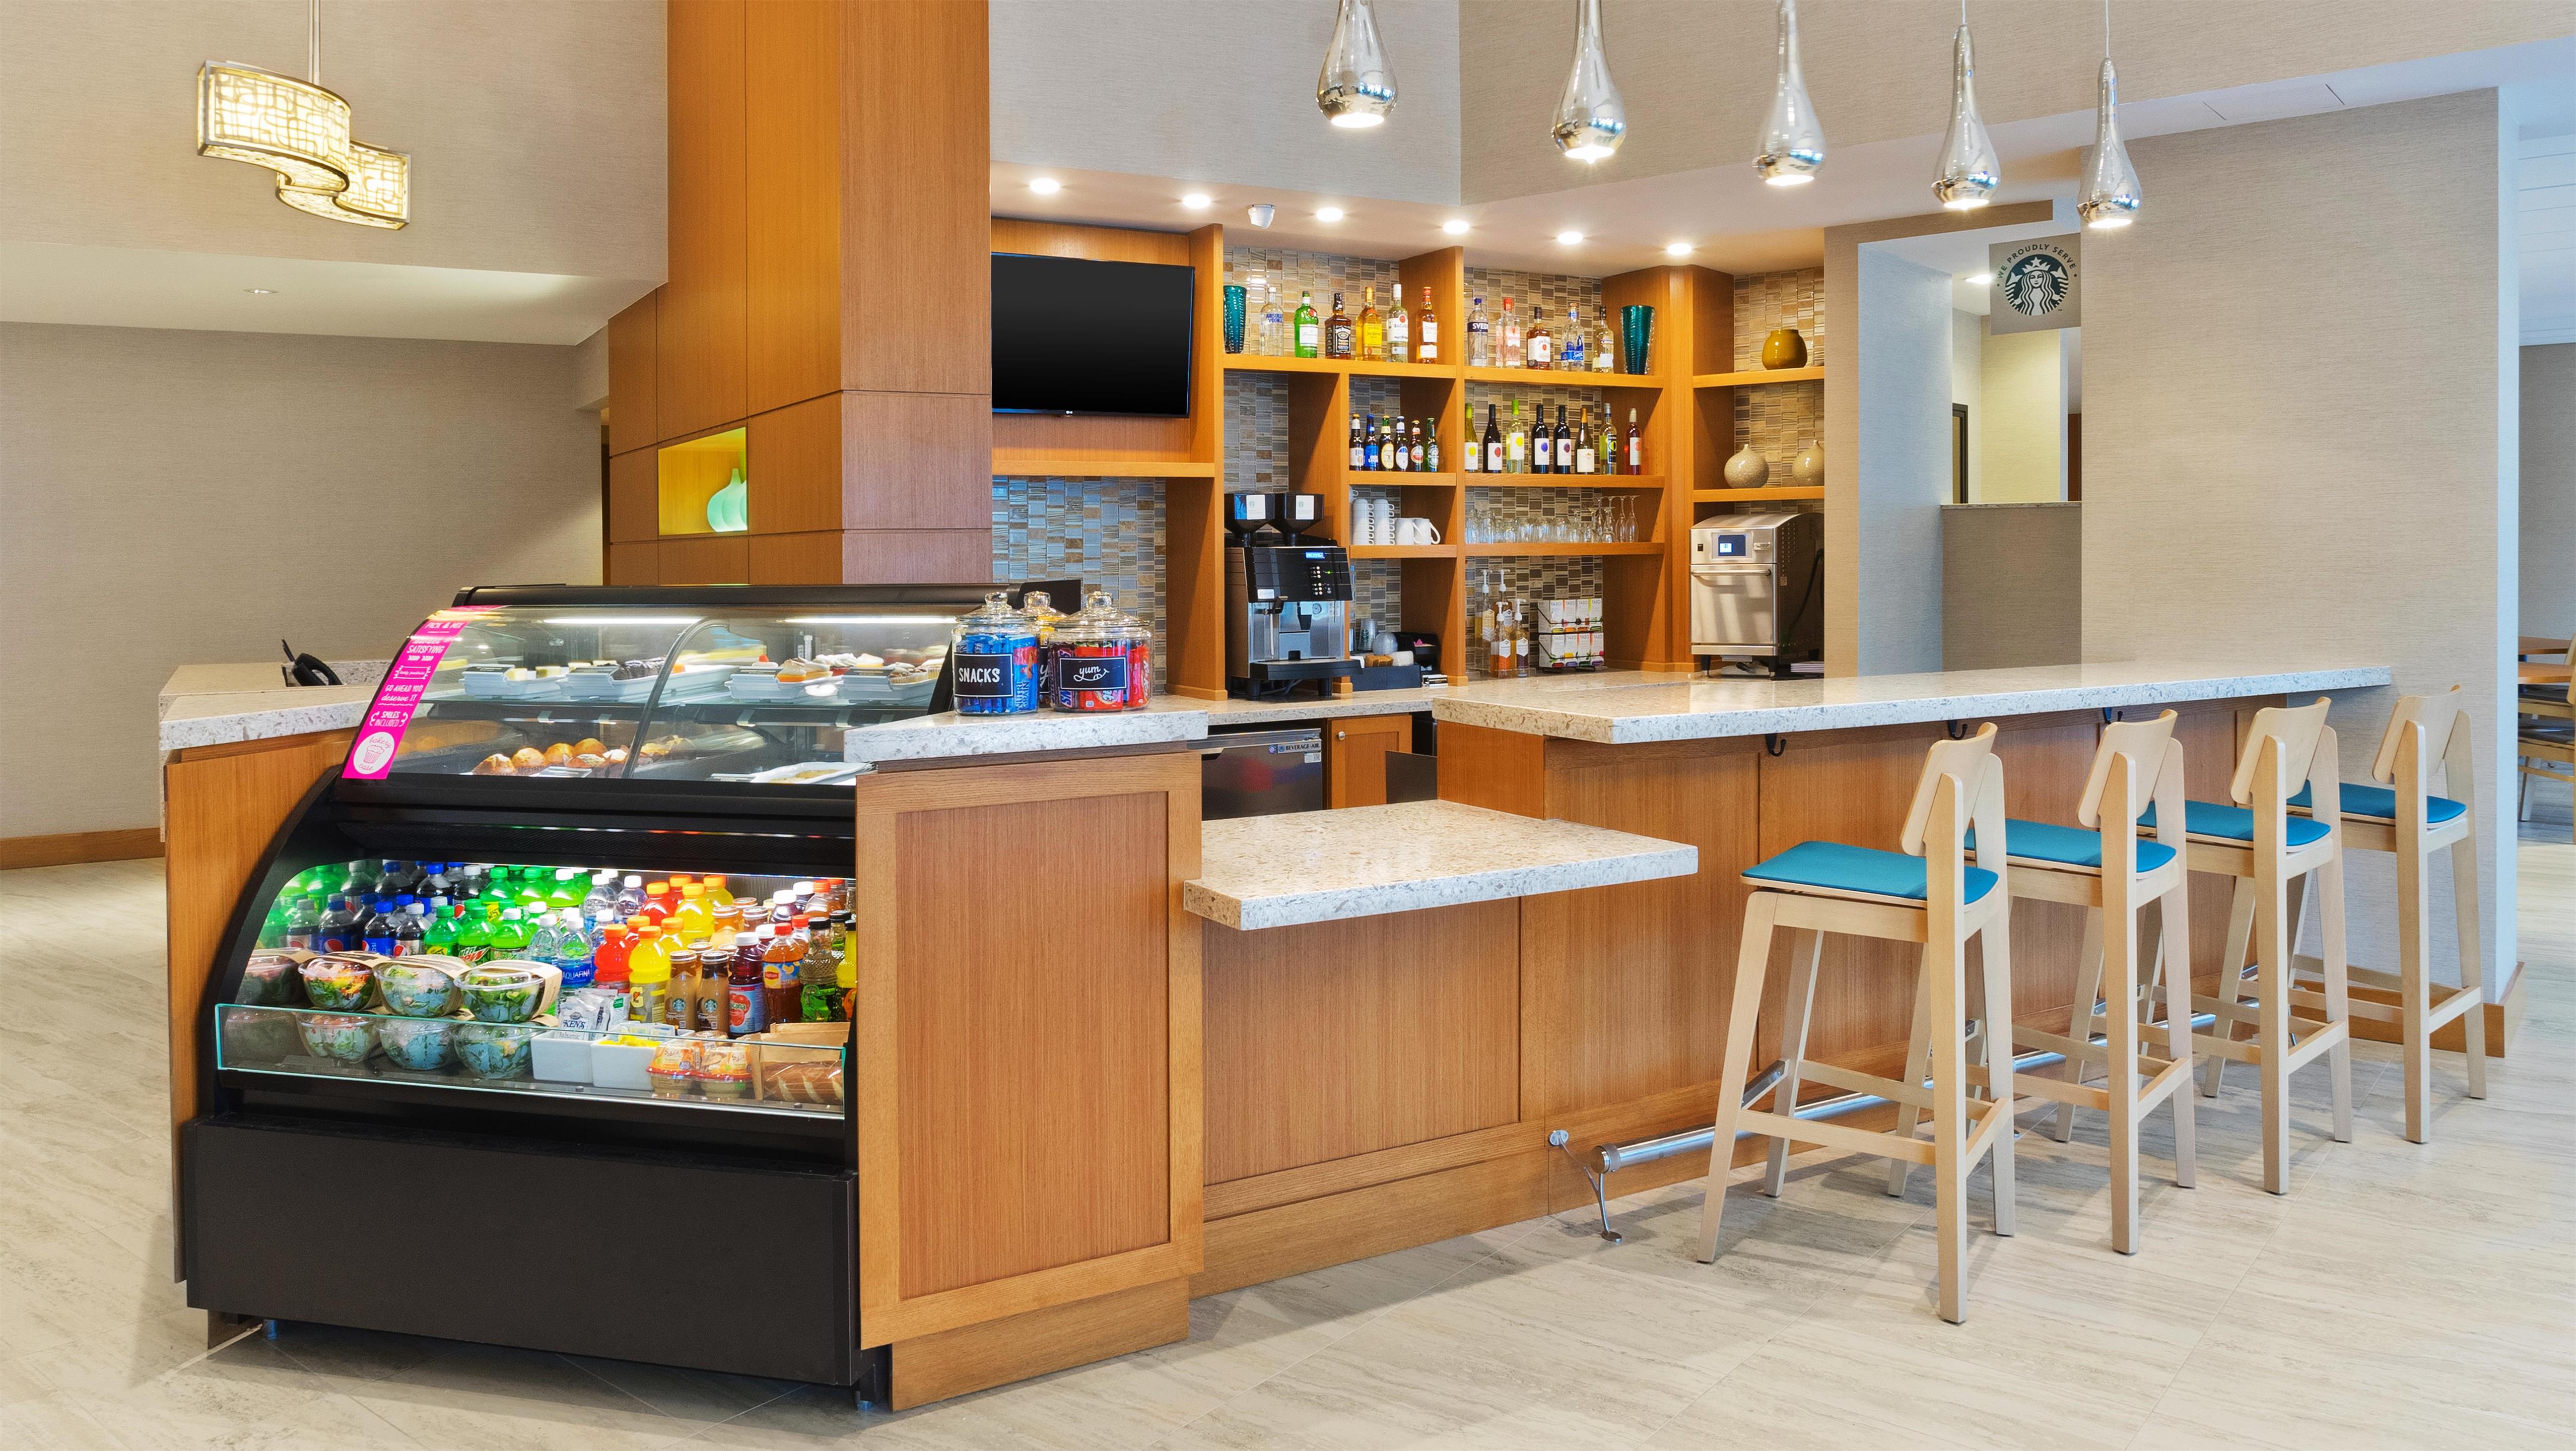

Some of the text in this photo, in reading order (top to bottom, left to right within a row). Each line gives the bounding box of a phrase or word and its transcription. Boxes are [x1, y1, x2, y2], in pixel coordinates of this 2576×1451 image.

[1998, 244, 2076, 279] WE PROUDLY SERVE
[406, 645, 445, 653] SATISFYING
[959, 668, 1000, 683] SNACKS
[1075, 666, 1103, 681] yum
[381, 693, 409, 701] deserve
[375, 719, 400, 727] INCLUDED
[369, 737, 392, 749] bakery
[562, 968, 590, 980] AQUAFINA
[630, 986, 644, 1008] G
